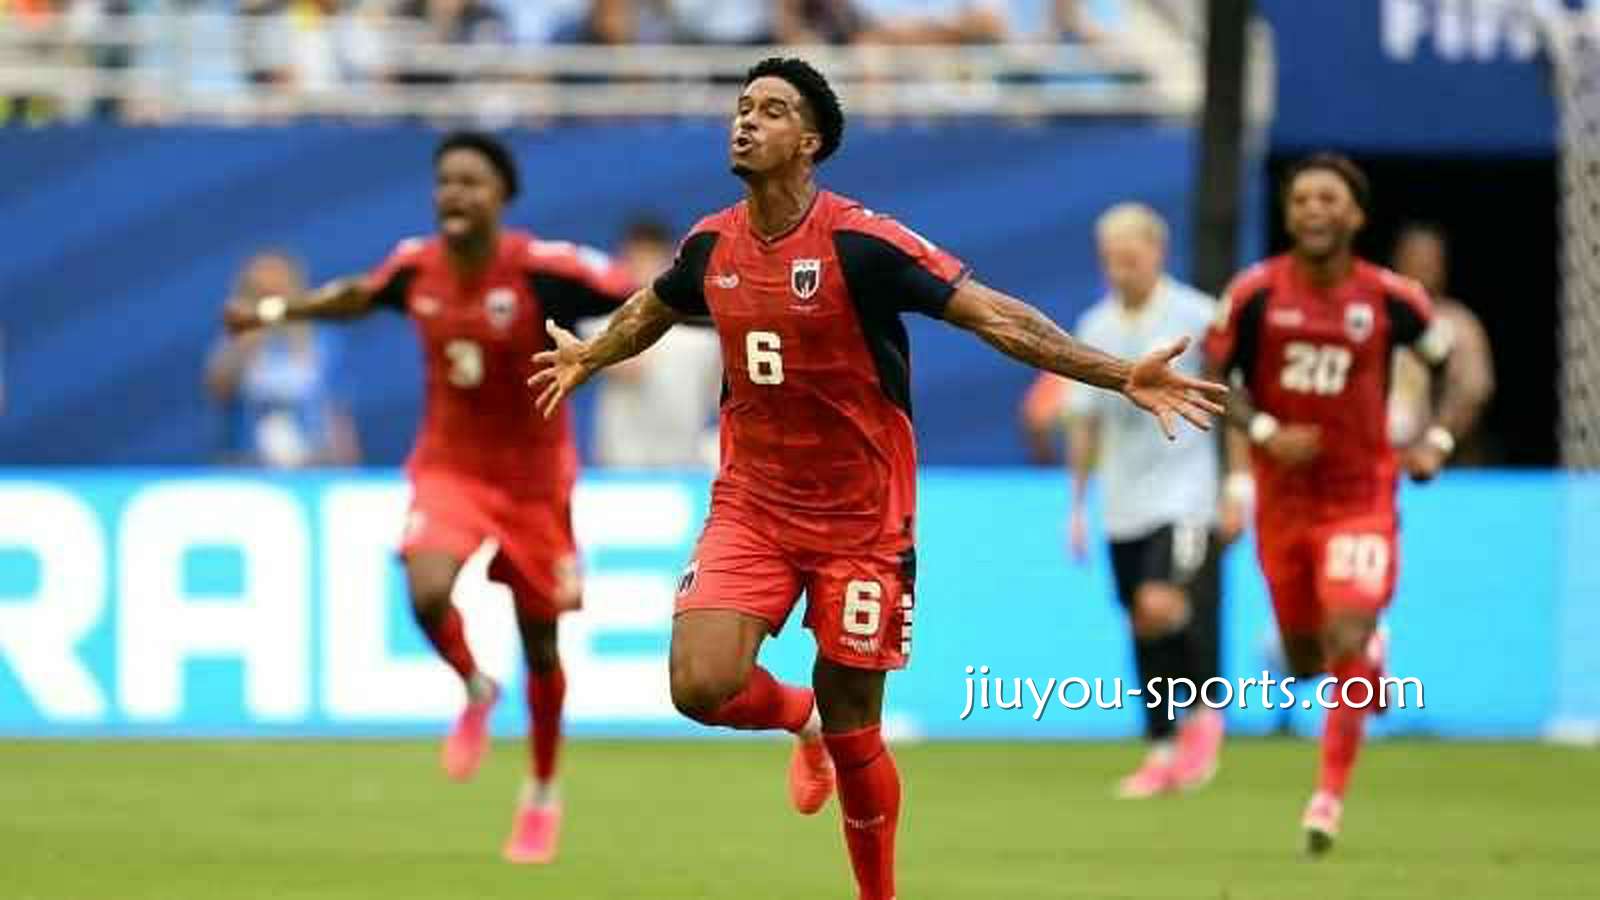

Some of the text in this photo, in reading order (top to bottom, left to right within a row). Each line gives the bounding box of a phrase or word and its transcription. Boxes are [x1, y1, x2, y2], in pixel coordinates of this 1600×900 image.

[745, 330, 784, 386] 6
[1280, 341, 1352, 396] 20
[842, 578, 883, 637] 6
